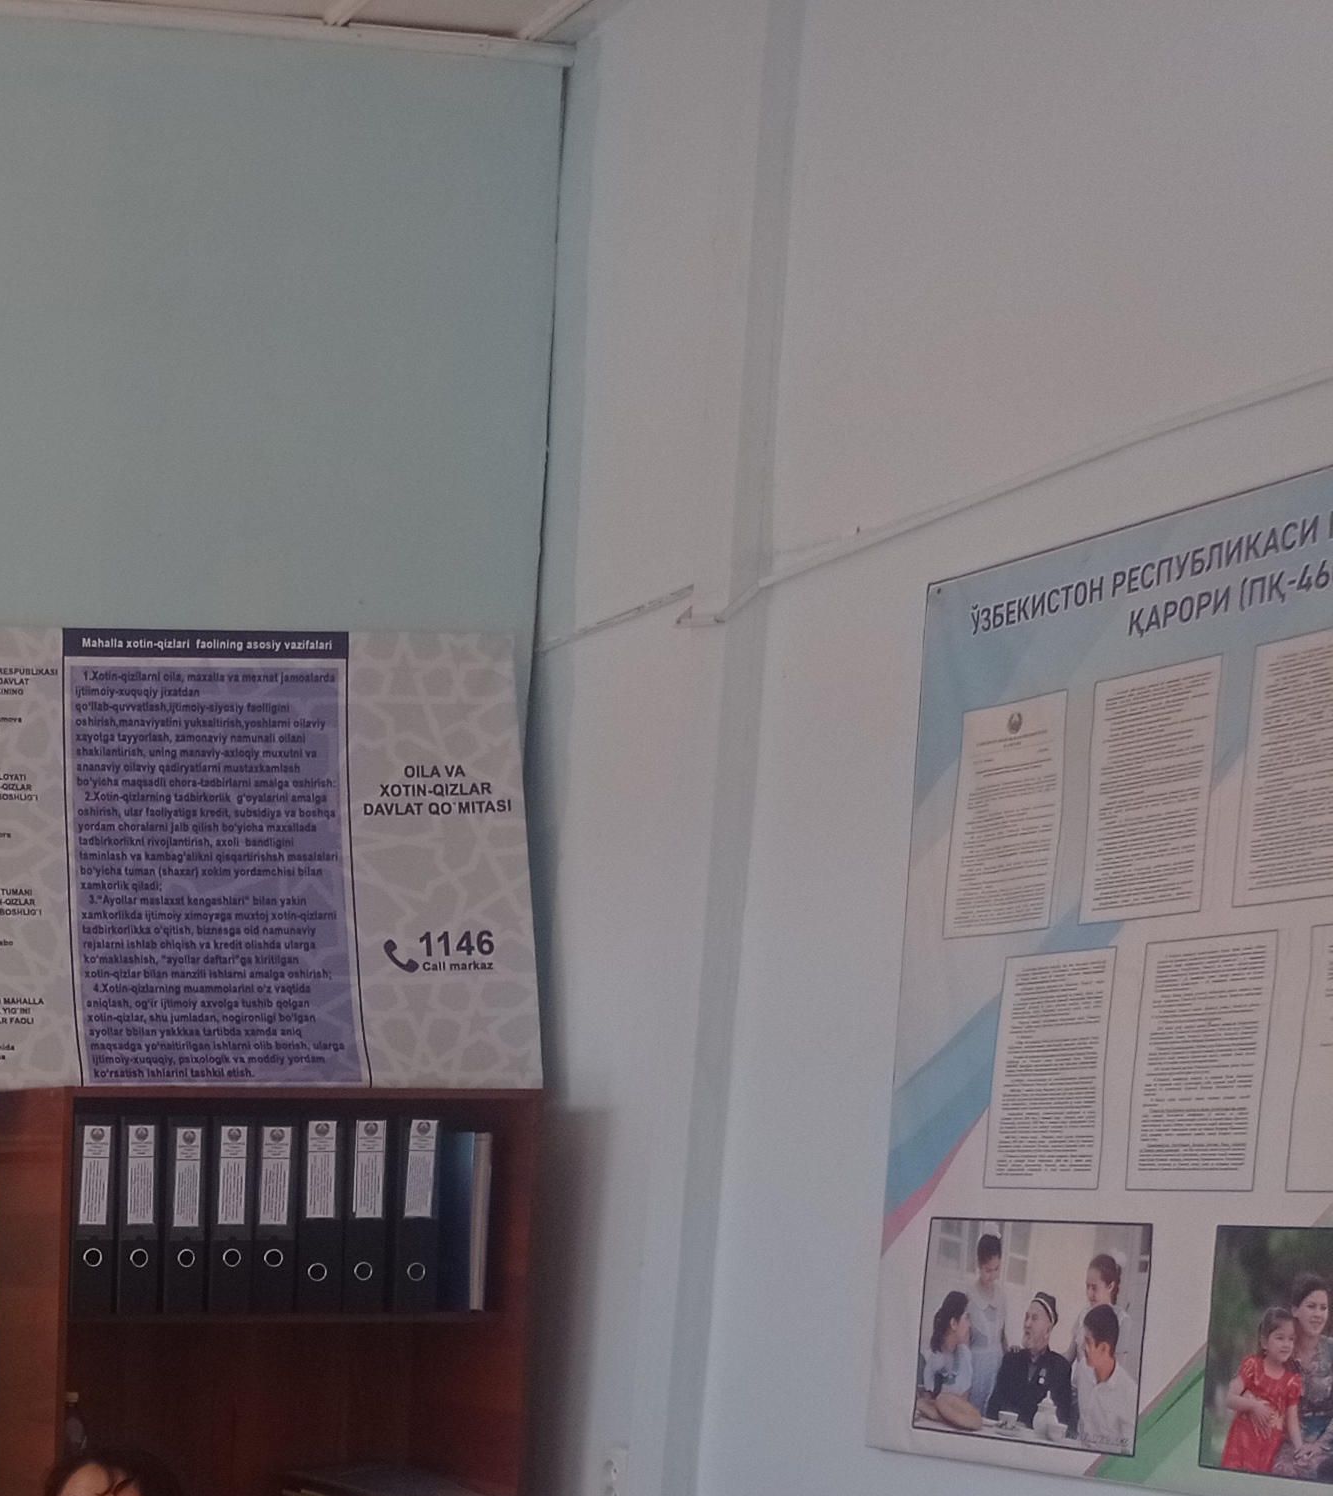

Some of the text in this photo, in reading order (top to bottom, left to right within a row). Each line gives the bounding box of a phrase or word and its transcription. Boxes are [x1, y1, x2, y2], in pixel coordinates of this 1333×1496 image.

[970, 577, 1104, 637] ЎЗБЕКИСТОН
[1112, 515, 1319, 598] РЕСПУБЛИКАСИ
[1129, 586, 1231, 638] ҚАРОРИ
[82, 638, 333, 652] Mahalla xotin-qizlari faolining asosiy vazifalari
[404, 765, 465, 778] OILA VA
[380, 783, 492, 797] XOTIN-QIZLAR
[363, 803, 423, 816] DAVLAT
[419, 930, 494, 957] 1146
[423, 961, 493, 971] Call markaz
